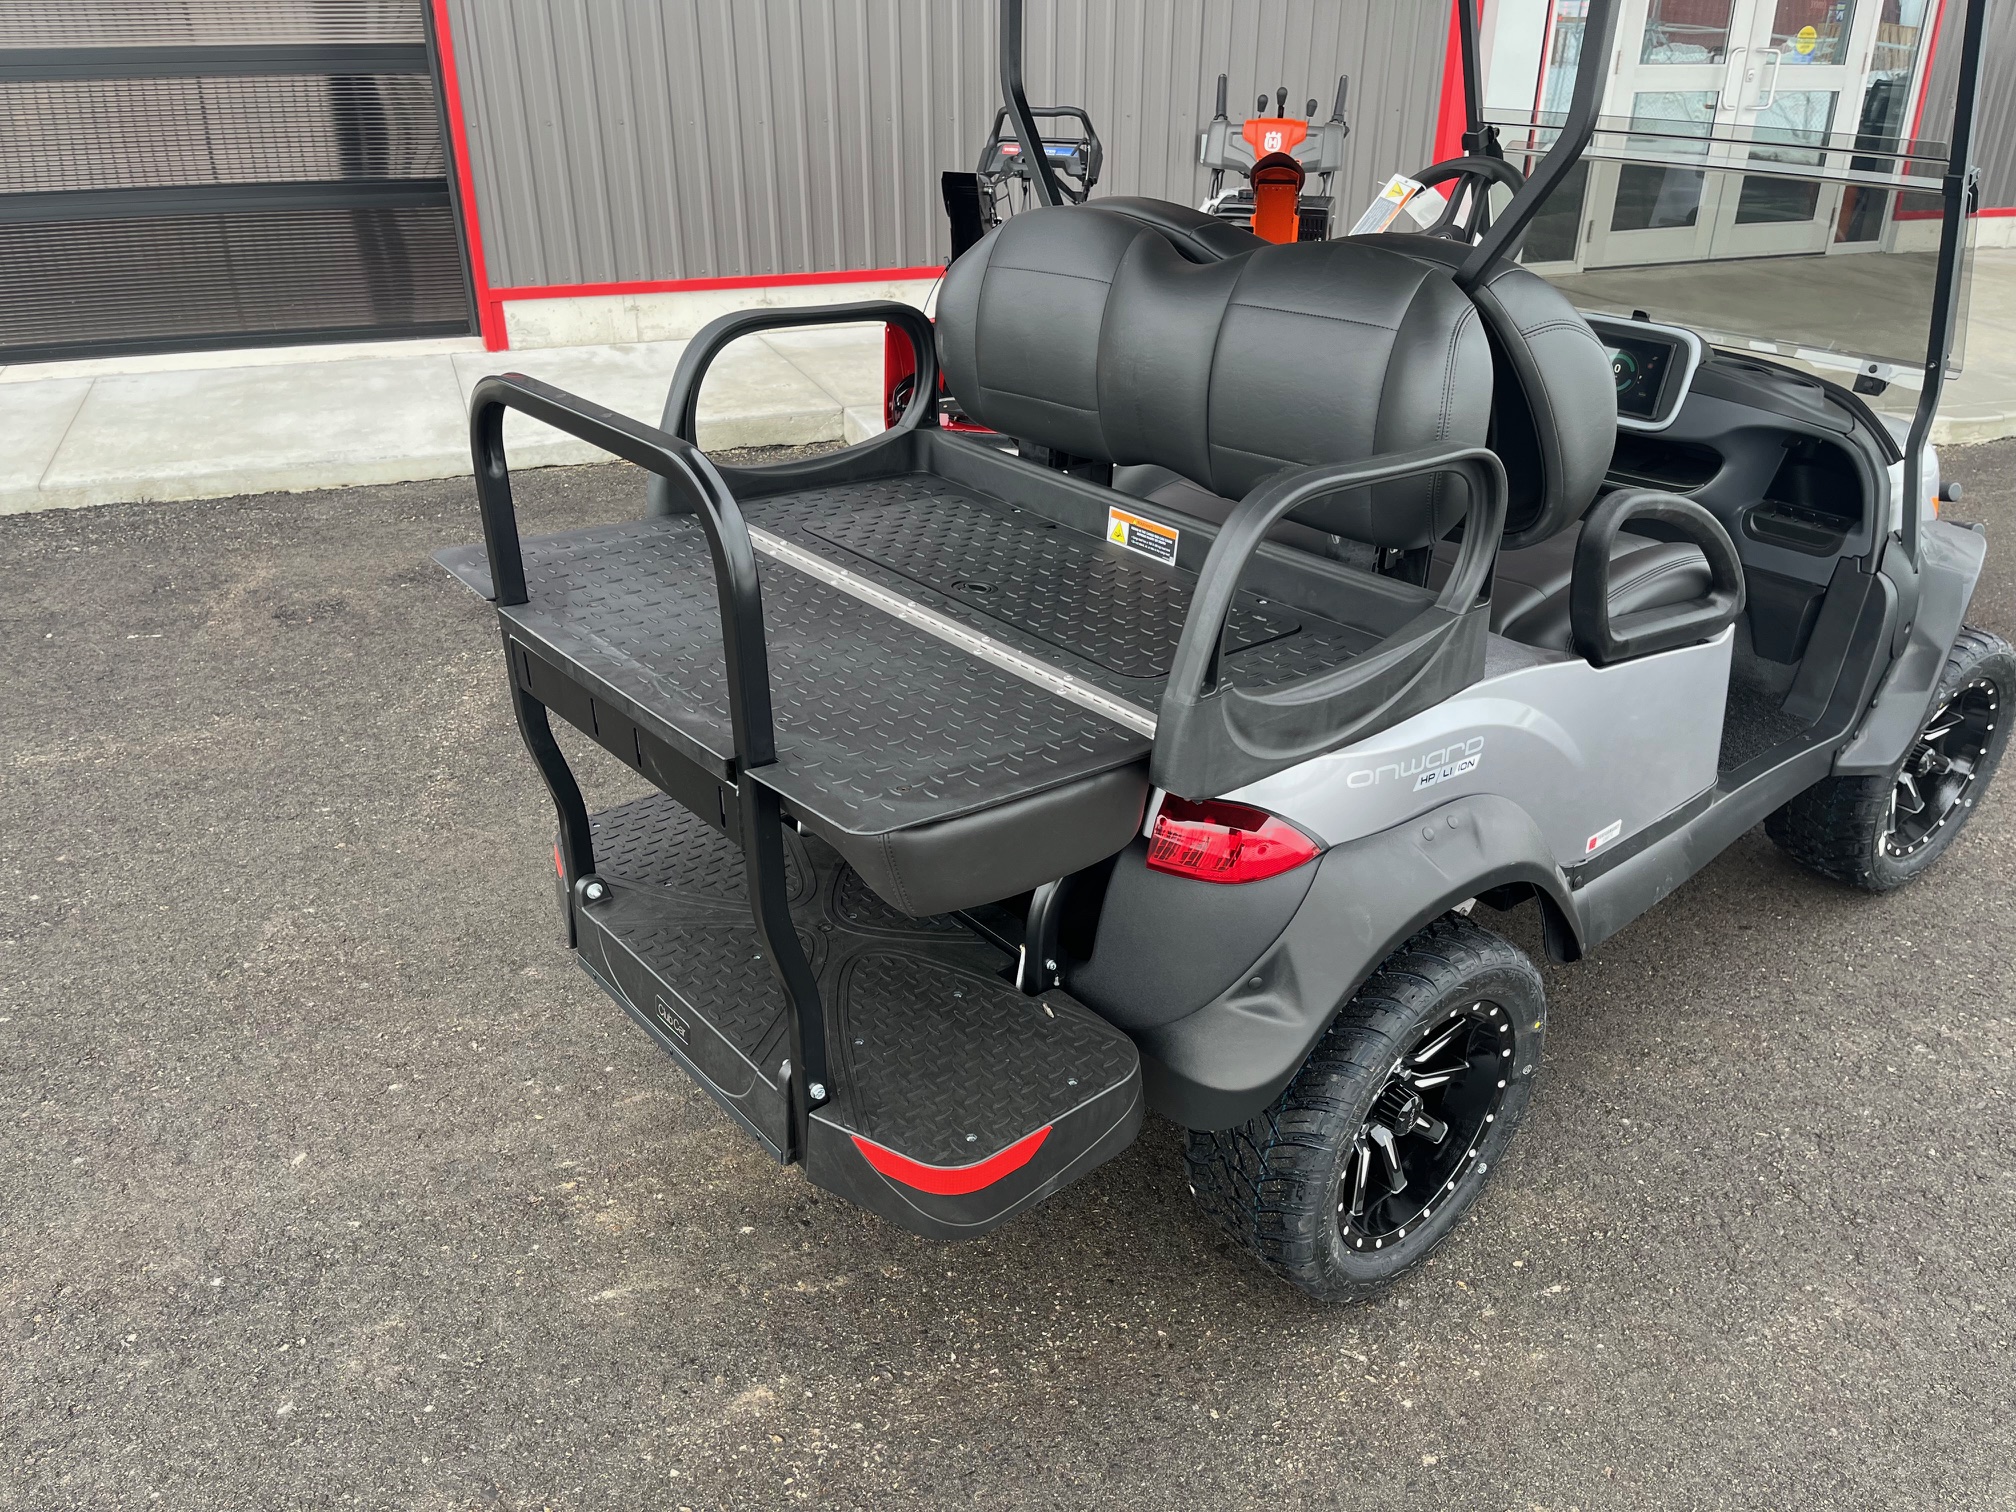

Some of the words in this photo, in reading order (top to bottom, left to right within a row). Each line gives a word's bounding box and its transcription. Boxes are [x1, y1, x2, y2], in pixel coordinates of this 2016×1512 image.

[1614, 363, 1621, 373] 0
[658, 1003, 674, 1026] Club
[673, 1018, 686, 1038] Car
